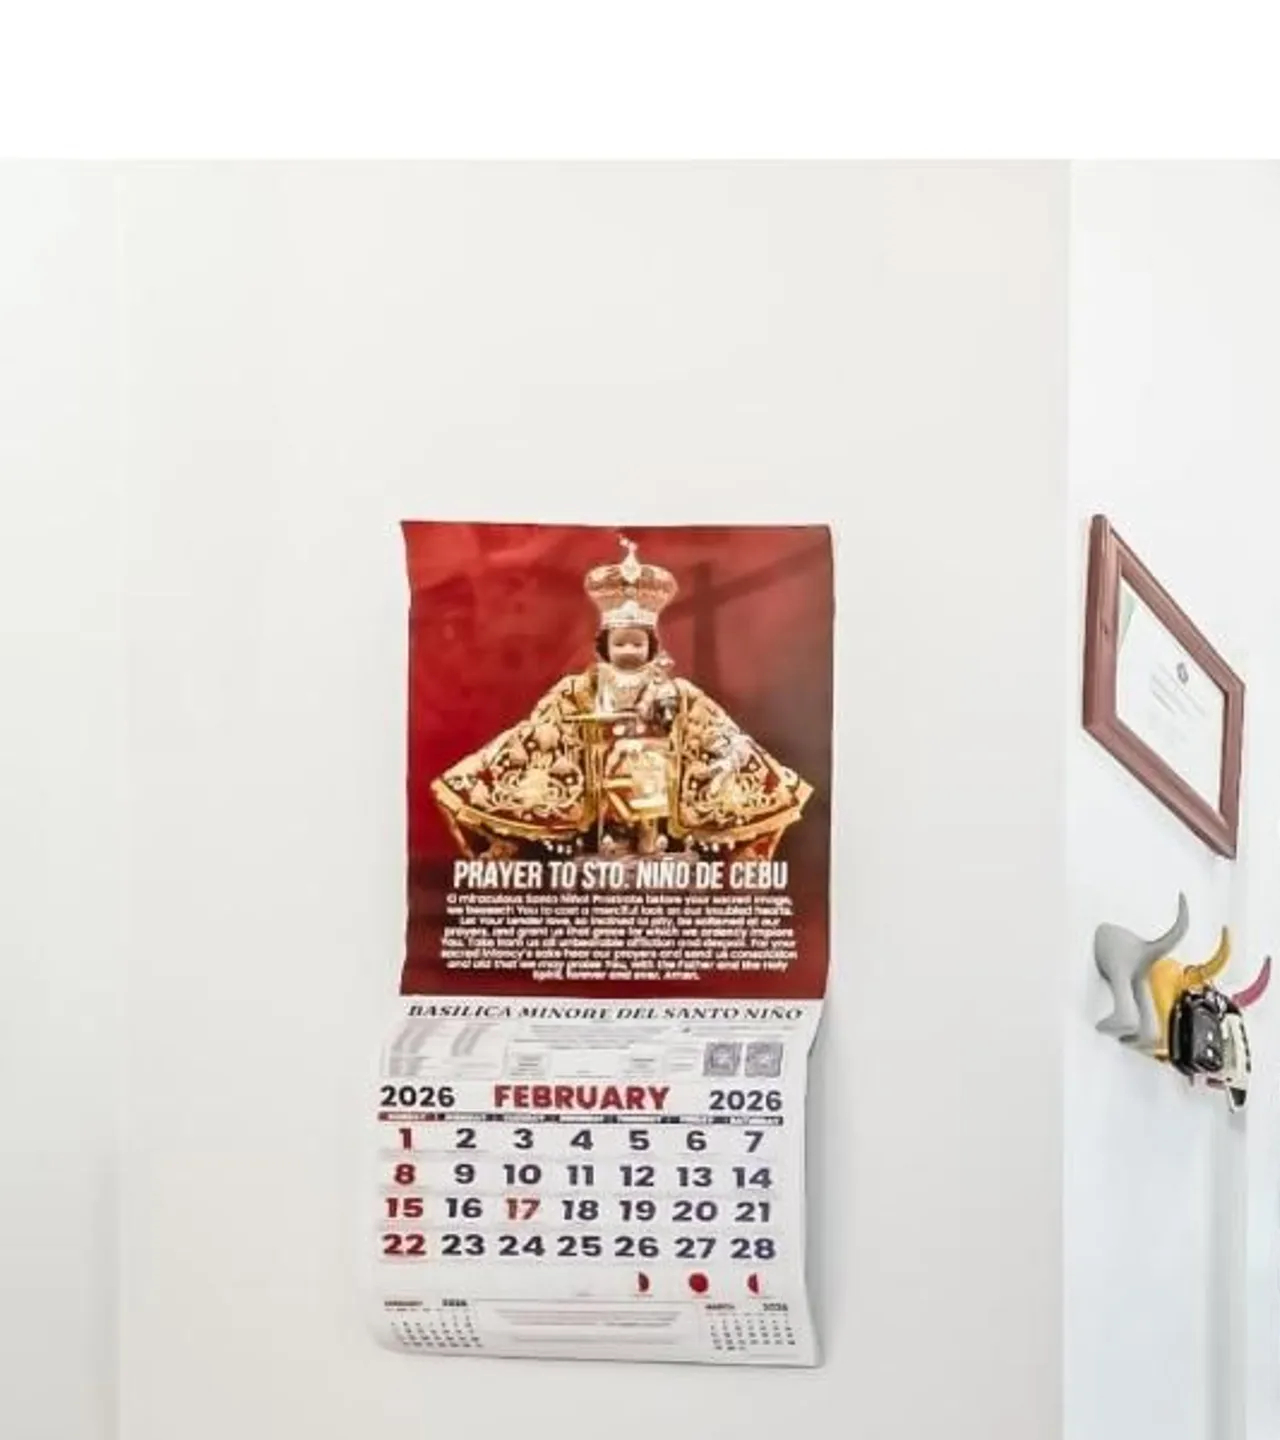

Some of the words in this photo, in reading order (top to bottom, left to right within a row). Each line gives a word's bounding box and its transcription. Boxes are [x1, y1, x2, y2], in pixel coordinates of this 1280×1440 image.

[454, 861, 542, 889] PRAYER
[549, 861, 577, 889] TO
[581, 861, 630, 889] STO.
[636, 857, 690, 889] NIÑO
[696, 861, 724, 889] DE
[729, 861, 788, 889] CEBU
[407, 1005, 511, 1017] BASILICA
[517, 1005, 607, 1019] MINORE
[616, 1007, 657, 1019] DEL
[663, 1008, 739, 1020] SANTO
[743, 1004, 803, 1020] NIÑO
[380, 1086, 455, 1108] 2026
[494, 1084, 670, 1110] FEBRUARY
[709, 1090, 783, 1112] 2026
[399, 1128, 412, 1149] 1
[456, 1128, 477, 1148] 2
[513, 1128, 534, 1149] 3
[570, 1129, 594, 1150] 4
[629, 1130, 650, 1151] 5
[686, 1131, 707, 1151] 6
[744, 1131, 764, 1153] 7
[394, 1164, 415, 1184] 8
[454, 1164, 475, 1184] 9
[503, 1164, 542, 1185] 10
[566, 1165, 594, 1186] 11
[620, 1166, 655, 1187] 12
[676, 1166, 713, 1187] 13
[732, 1167, 772, 1189] 14
[385, 1198, 424, 1218] 15
[445, 1198, 483, 1218] 16
[506, 1199, 541, 1220] 17
[562, 1199, 599, 1220] 18
[619, 1200, 656, 1221] 19
[672, 1201, 718, 1222] 20
[735, 1202, 770, 1223] 21
[383, 1234, 426, 1256] 22
[441, 1234, 485, 1256] 23
[499, 1235, 545, 1256] 24
[557, 1236, 602, 1257] 25
[615, 1237, 659, 1257] 26
[675, 1238, 716, 1259] 27
[730, 1238, 776, 1260] 28
